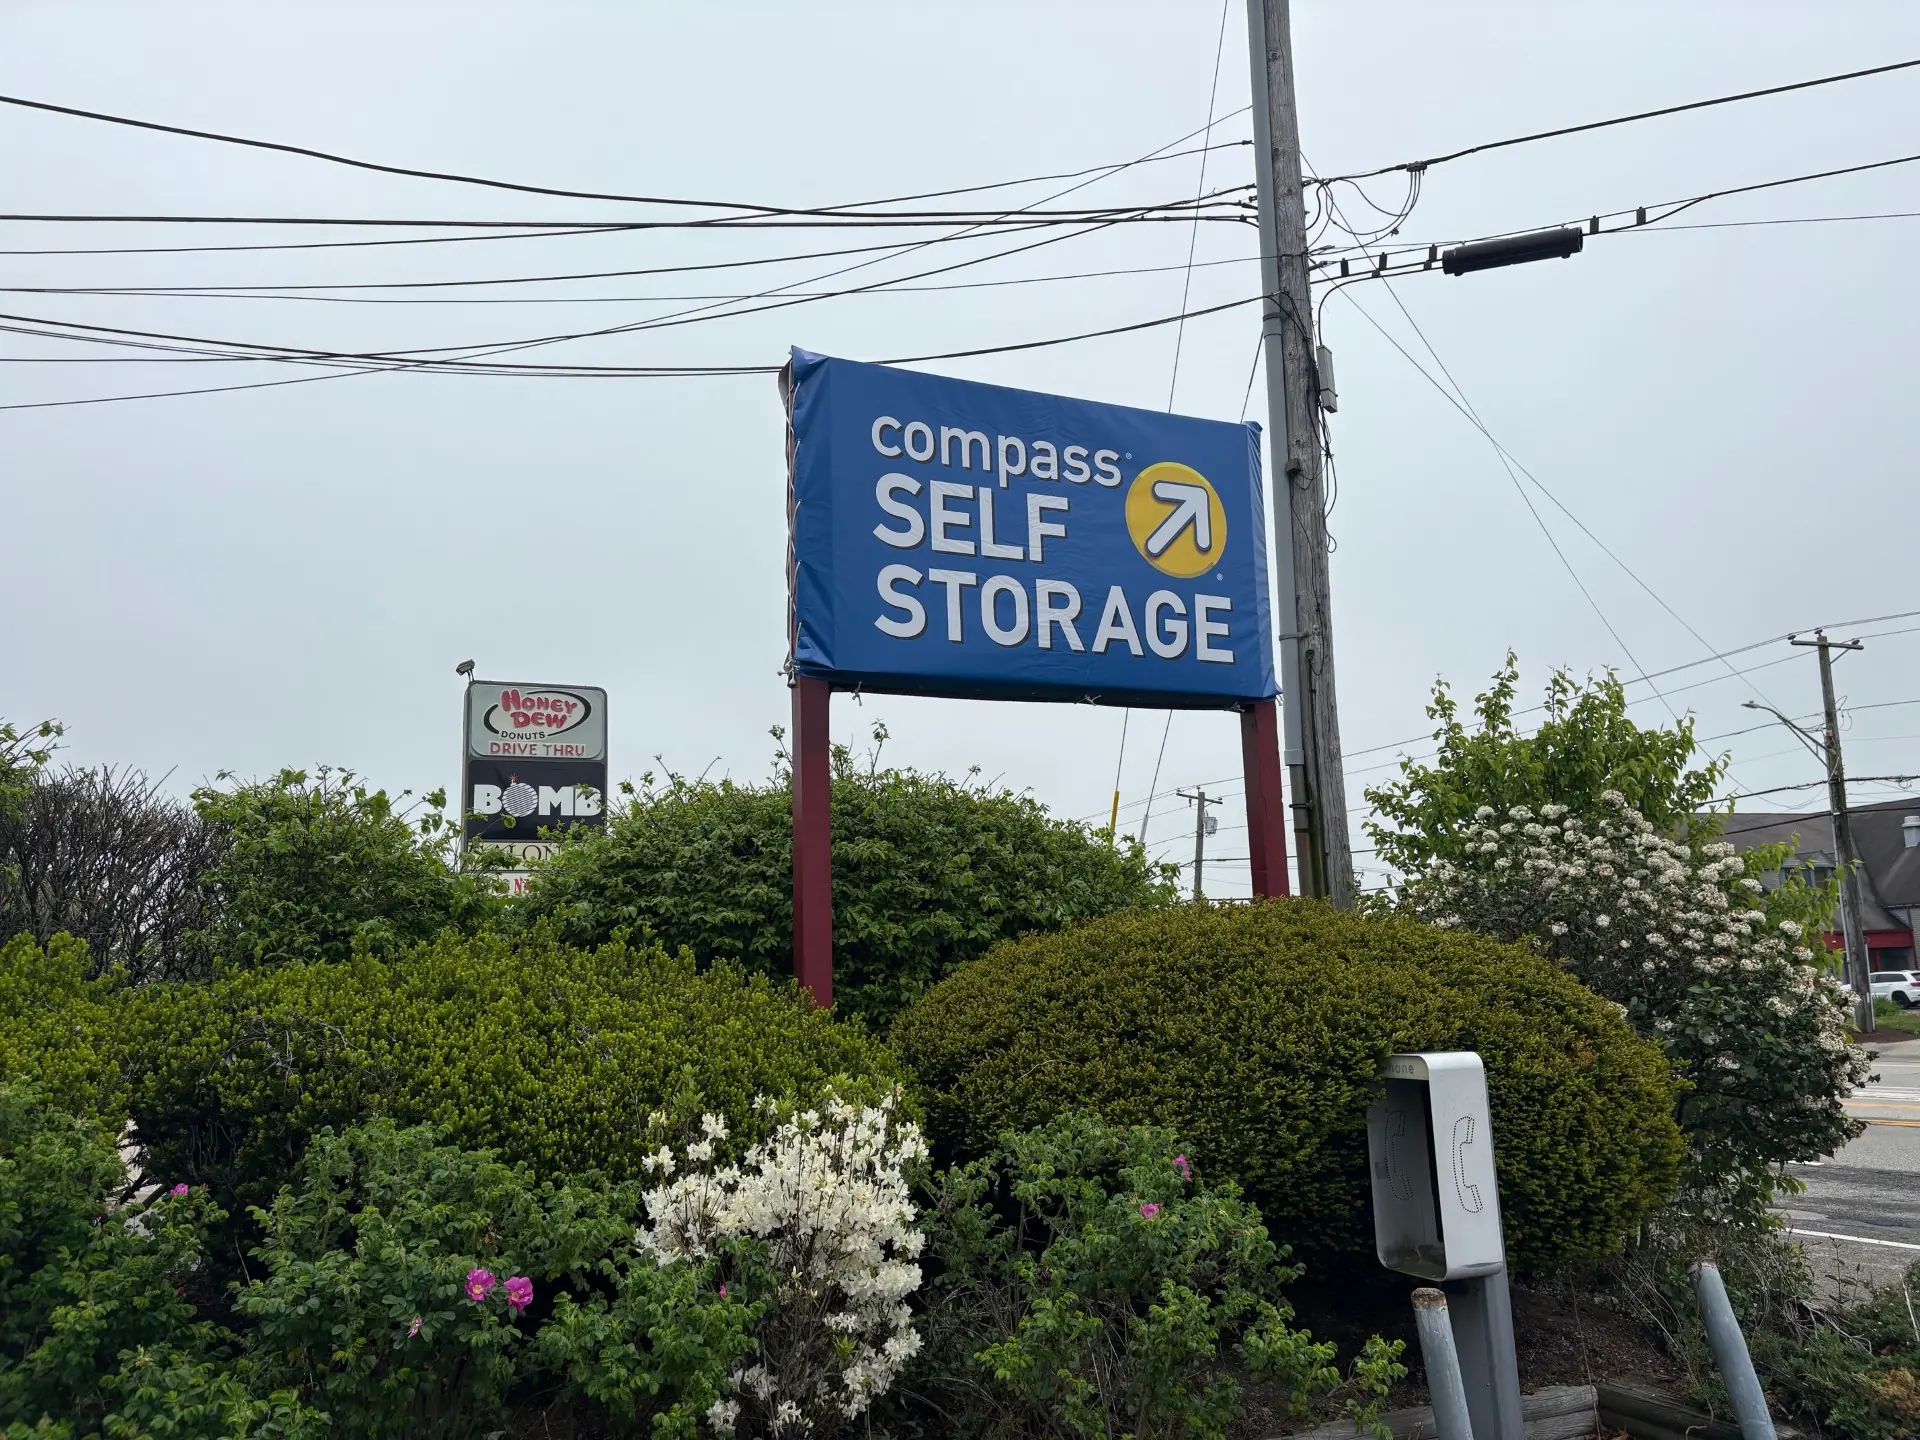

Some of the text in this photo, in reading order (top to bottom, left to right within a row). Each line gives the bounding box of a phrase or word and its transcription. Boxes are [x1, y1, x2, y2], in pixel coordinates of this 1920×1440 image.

[872, 472, 1069, 563] SELF
[873, 563, 1236, 664] STORAGE
[501, 689, 577, 714] HONEY
[510, 711, 568, 728] DEW
[501, 730, 546, 740] DONUTS
[489, 742, 585, 756] DRIVE THRU
